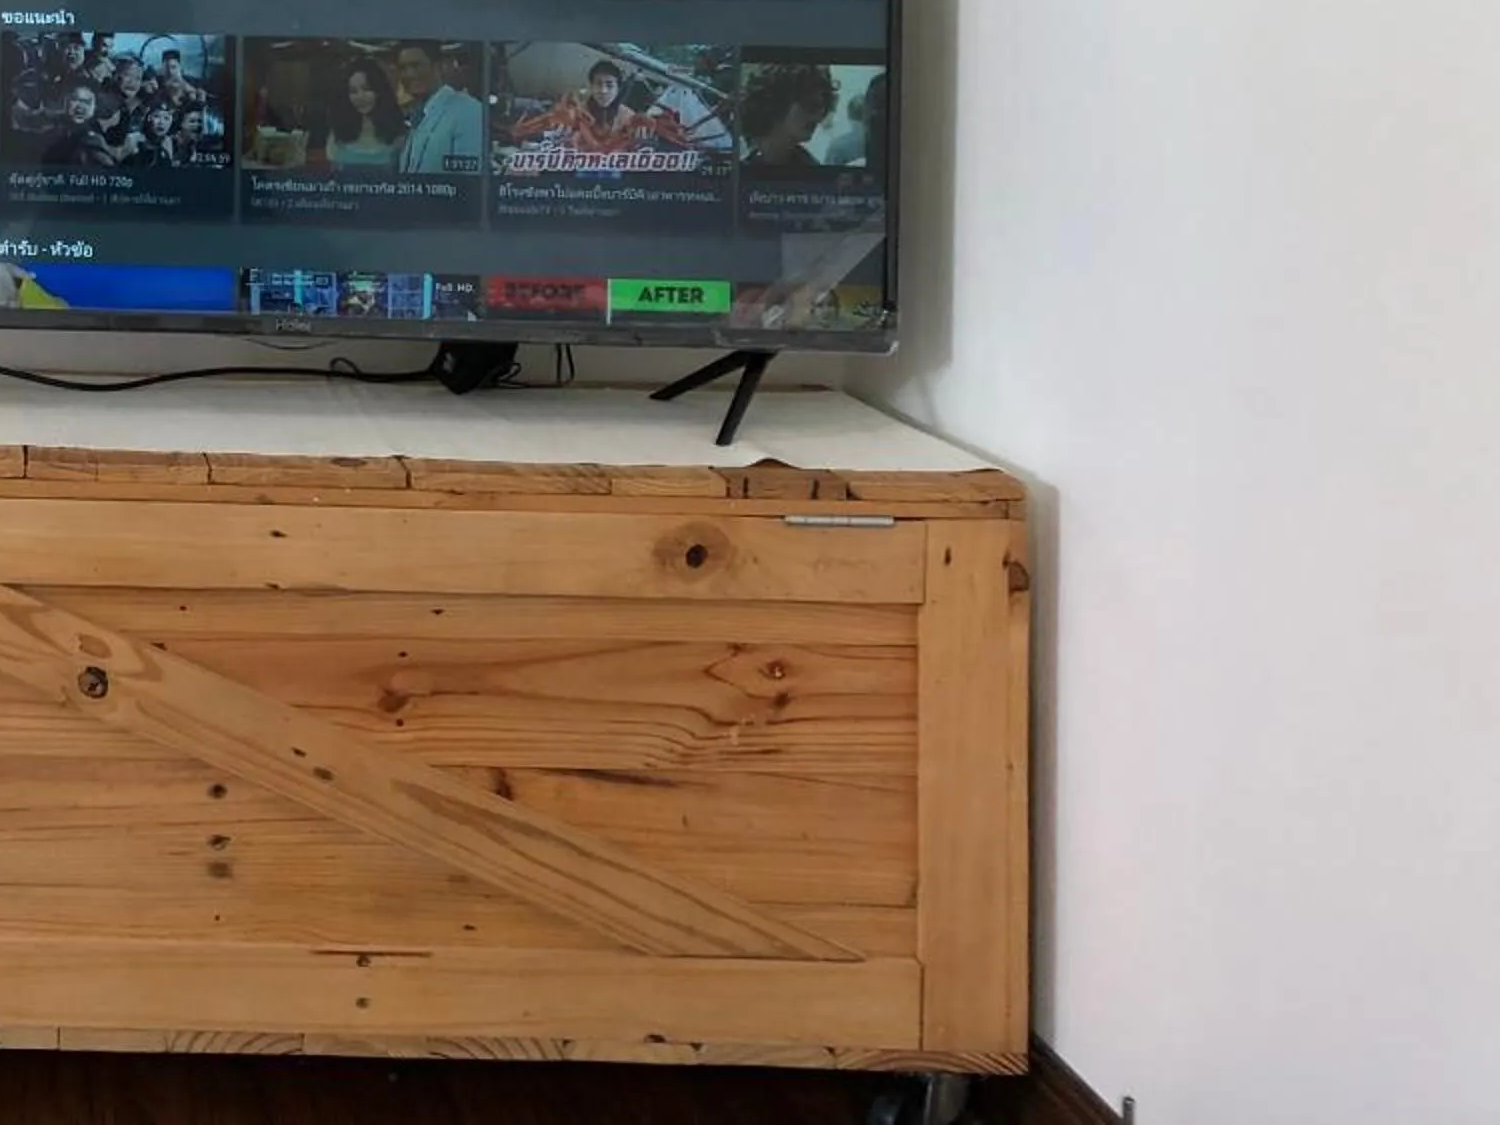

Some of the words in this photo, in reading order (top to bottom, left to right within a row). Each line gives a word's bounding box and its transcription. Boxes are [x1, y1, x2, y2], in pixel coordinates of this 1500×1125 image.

[0, 8, 75, 25] ขอแนะนำ
[49, 241, 94, 258] หัวข้อ
[637, 285, 706, 305] AFTER
